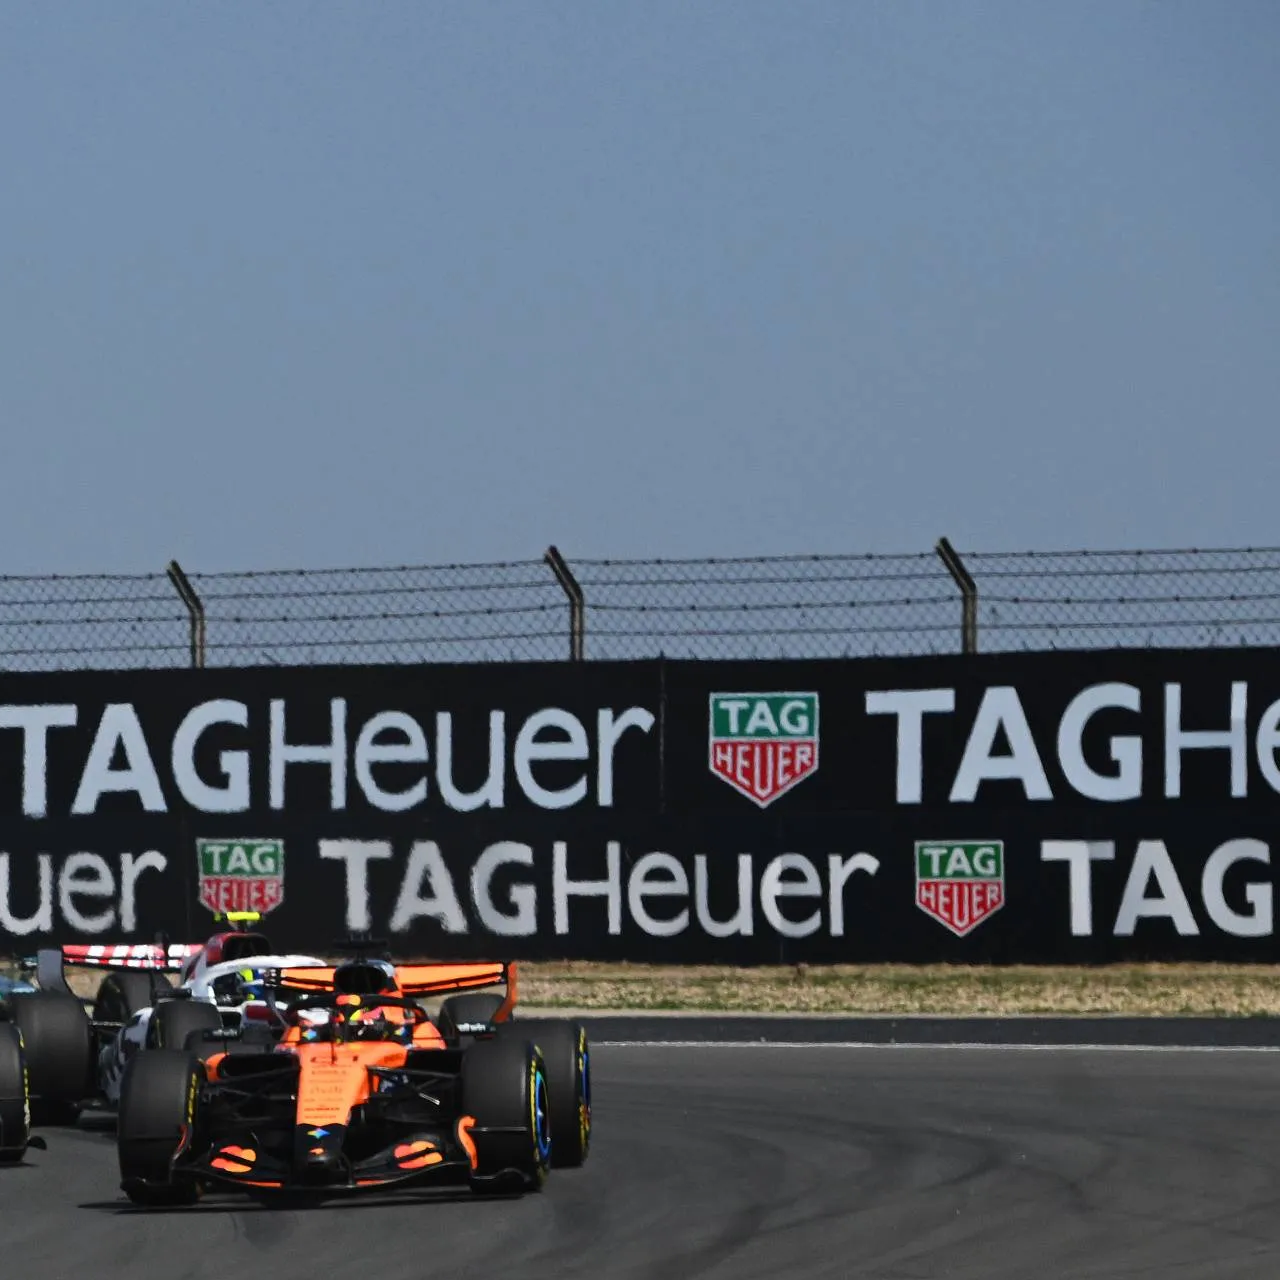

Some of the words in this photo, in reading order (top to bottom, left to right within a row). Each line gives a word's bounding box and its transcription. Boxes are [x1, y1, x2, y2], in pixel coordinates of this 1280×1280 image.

[718, 699, 810, 735] TAG
[715, 743, 815, 798] HEUER
[202, 843, 276, 874] TAG
[922, 847, 997, 876] TAG
[204, 879, 280, 916] HEUER
[920, 883, 1000, 928] HEUER
